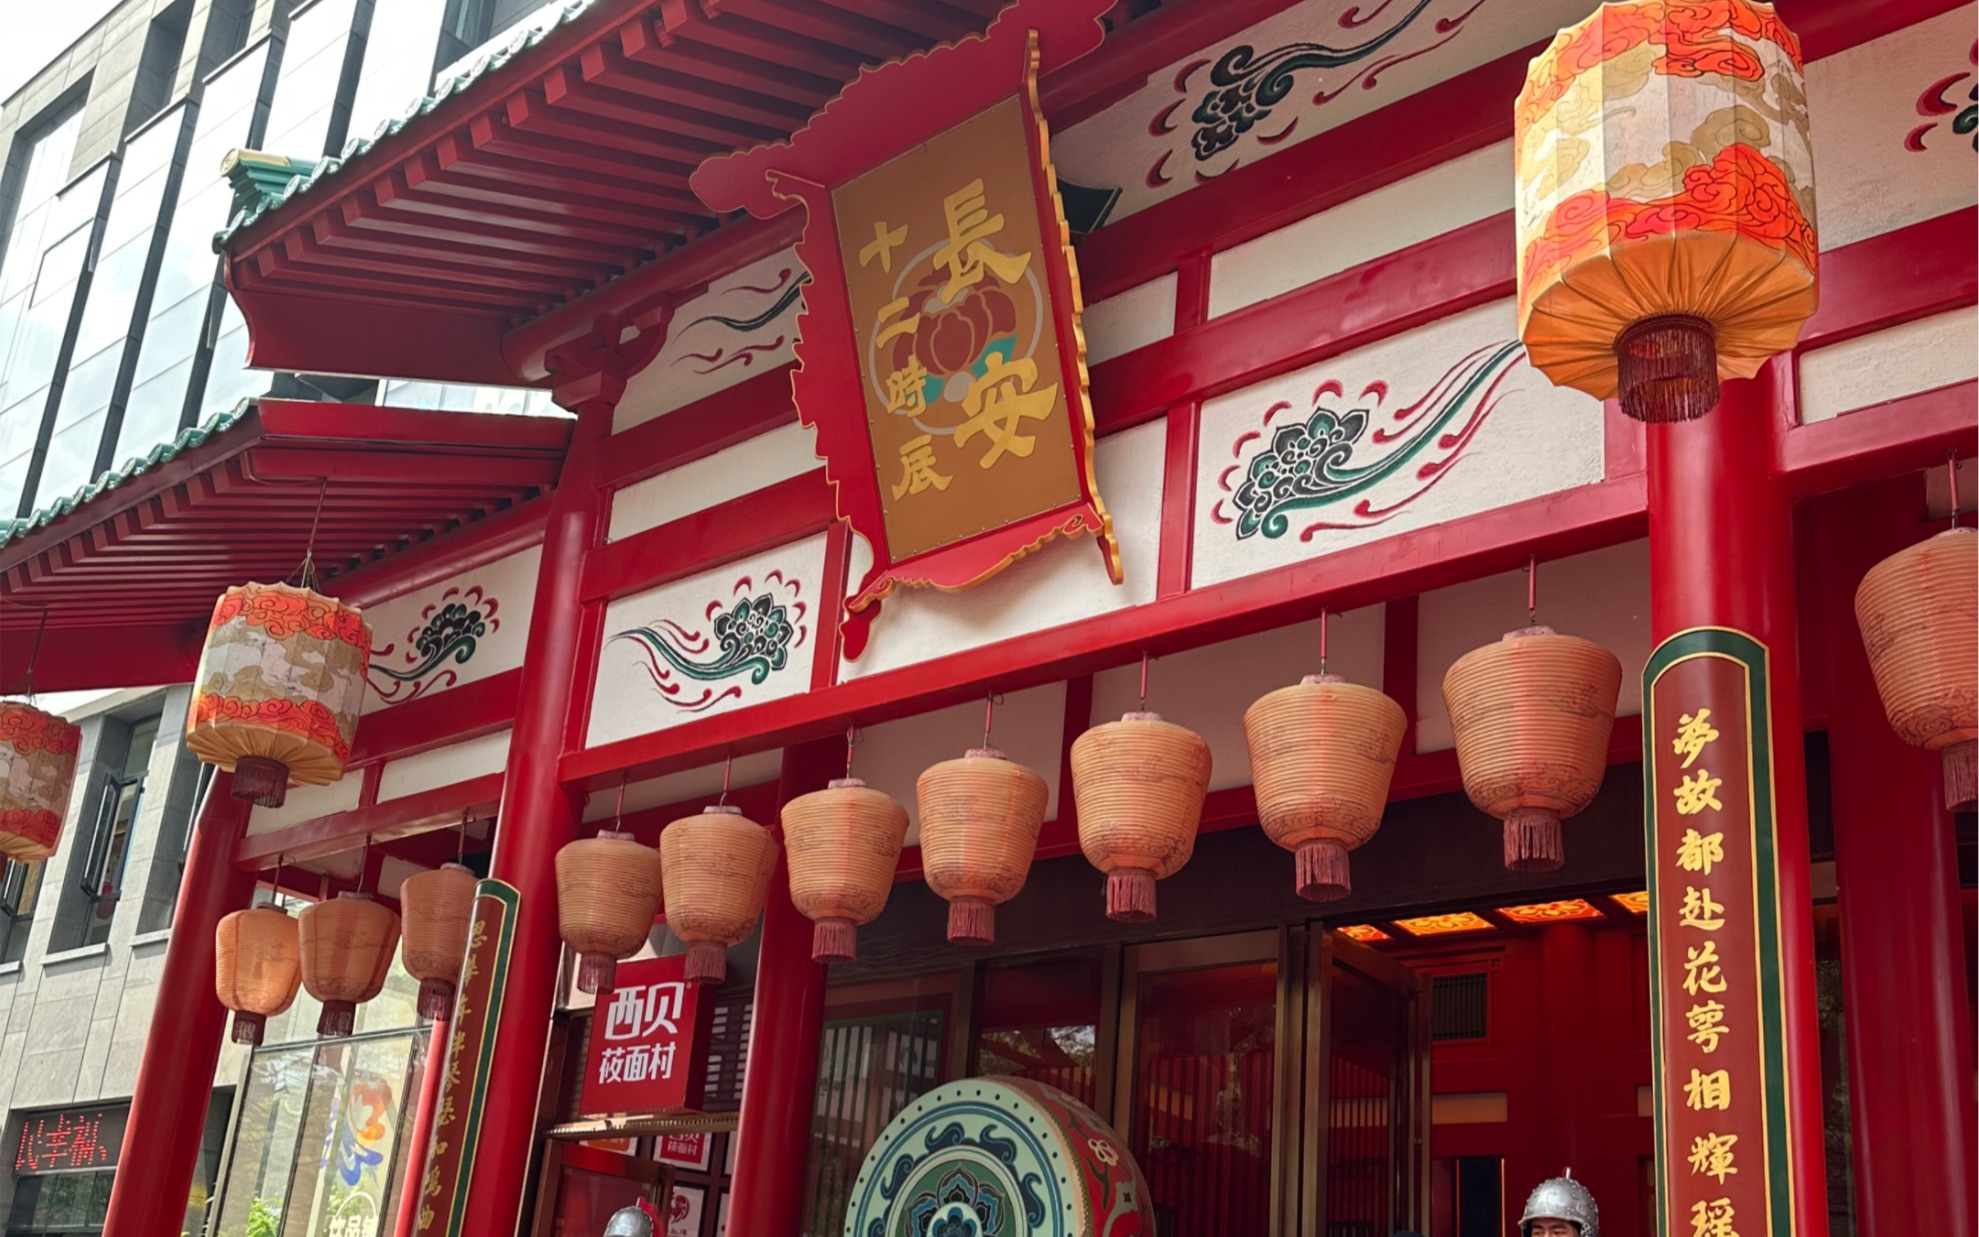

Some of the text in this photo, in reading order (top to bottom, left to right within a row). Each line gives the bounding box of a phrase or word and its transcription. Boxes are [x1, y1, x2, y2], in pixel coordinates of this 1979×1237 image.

[859, 221, 953, 502] 十二時辰
[931, 178, 1058, 470] 長安
[598, 1041, 677, 1084] 莜面村
[604, 981, 685, 1041] 西贝
